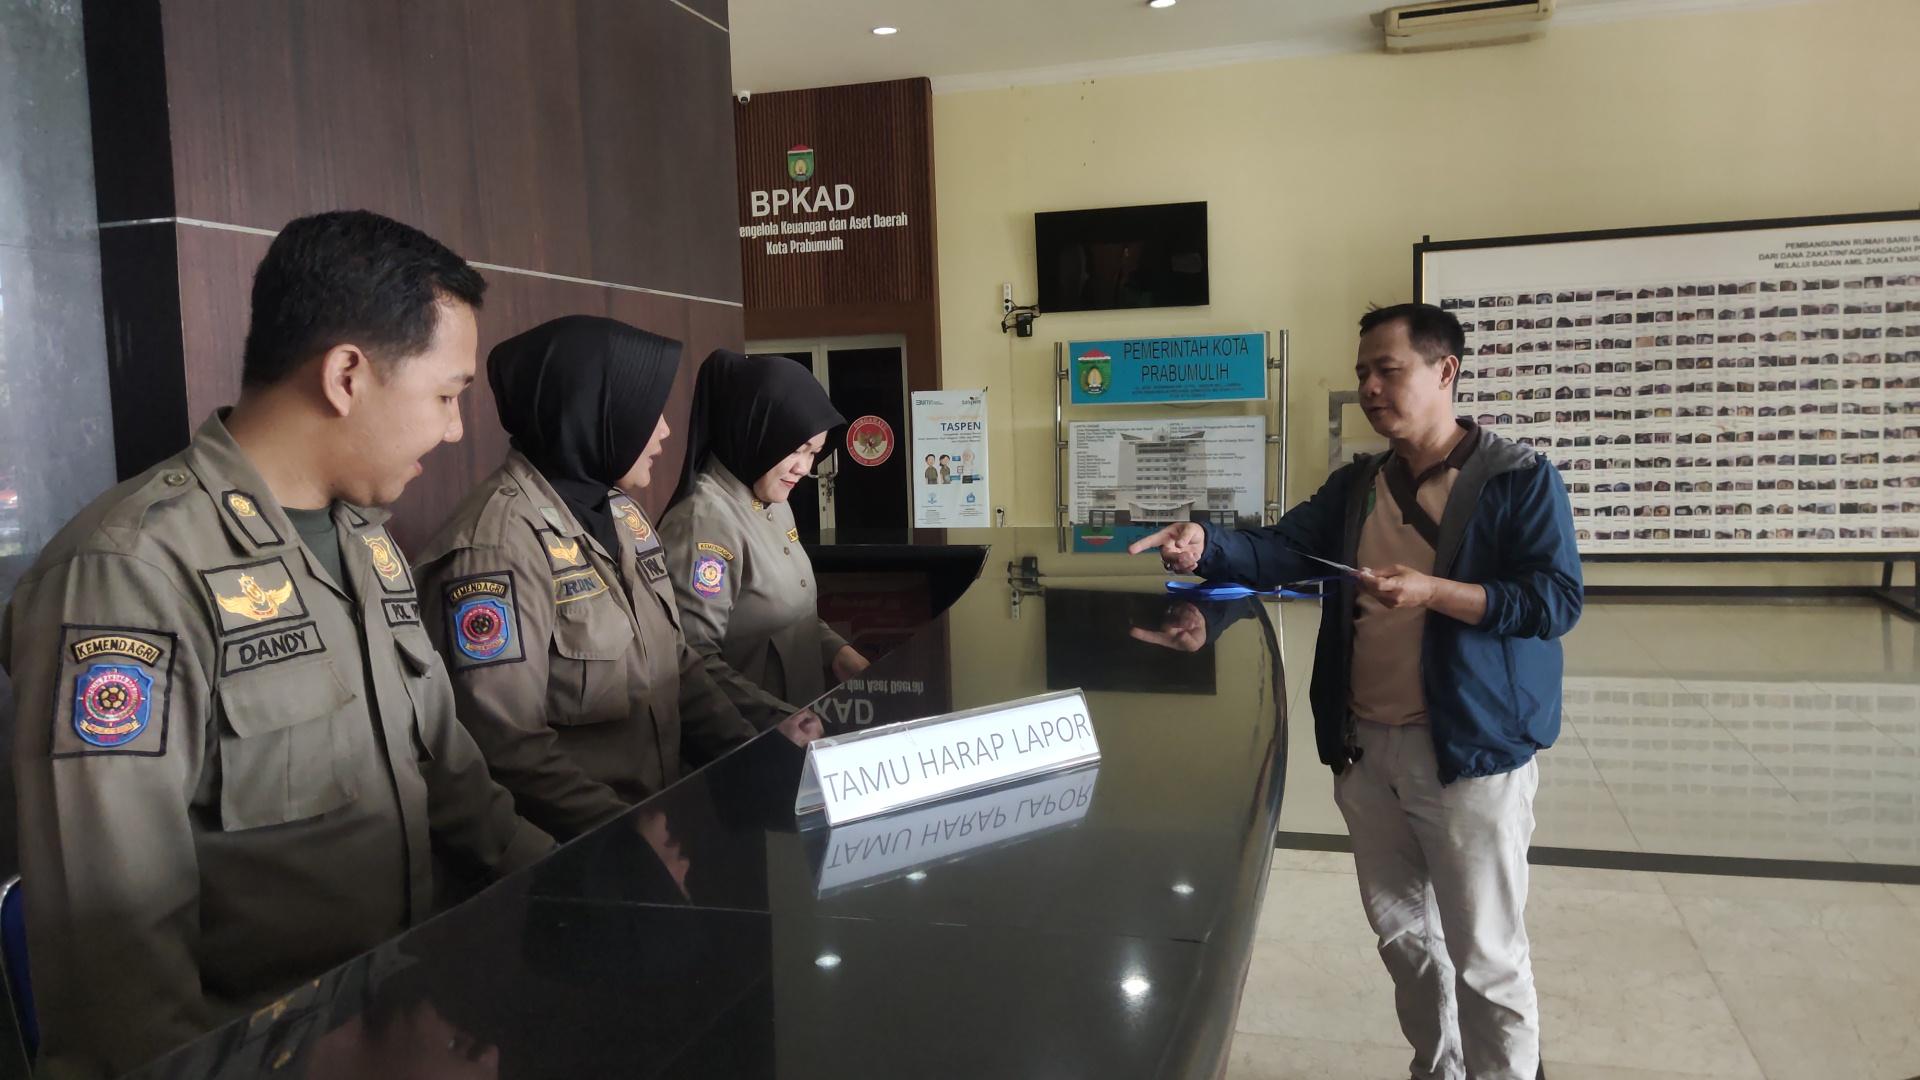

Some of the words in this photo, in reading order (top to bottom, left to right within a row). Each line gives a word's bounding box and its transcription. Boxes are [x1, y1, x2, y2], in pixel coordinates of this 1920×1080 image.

[751, 184, 855, 217] BPKAD
[739, 222, 779, 239] engelola
[781, 219, 827, 236] Keuangan
[829, 217, 847, 231] dan
[850, 215, 872, 230] Aset
[874, 212, 908, 228] Daerah
[766, 239, 788, 255] Kota
[790, 236, 844, 254] Prabumulih
[1853, 237, 1885, 246] RUMAH
[1780, 251, 1804, 260] DANA
[1812, 260, 1842, 268] BADAN
[1866, 256, 1894, 266] ZAKAT
[1123, 339, 1209, 359] PEMERINTAH
[1213, 337, 1249, 356] KOTA
[1141, 363, 1229, 382] PRABUMULIH
[940, 421, 981, 432] TASPEN
[77, 639, 158, 661] KEMENDAGRI
[239, 630, 308, 665] DANDY
[823, 756, 911, 803] TAMU
[918, 733, 1005, 779] HARAP
[1012, 713, 1091, 754] LAPOR
